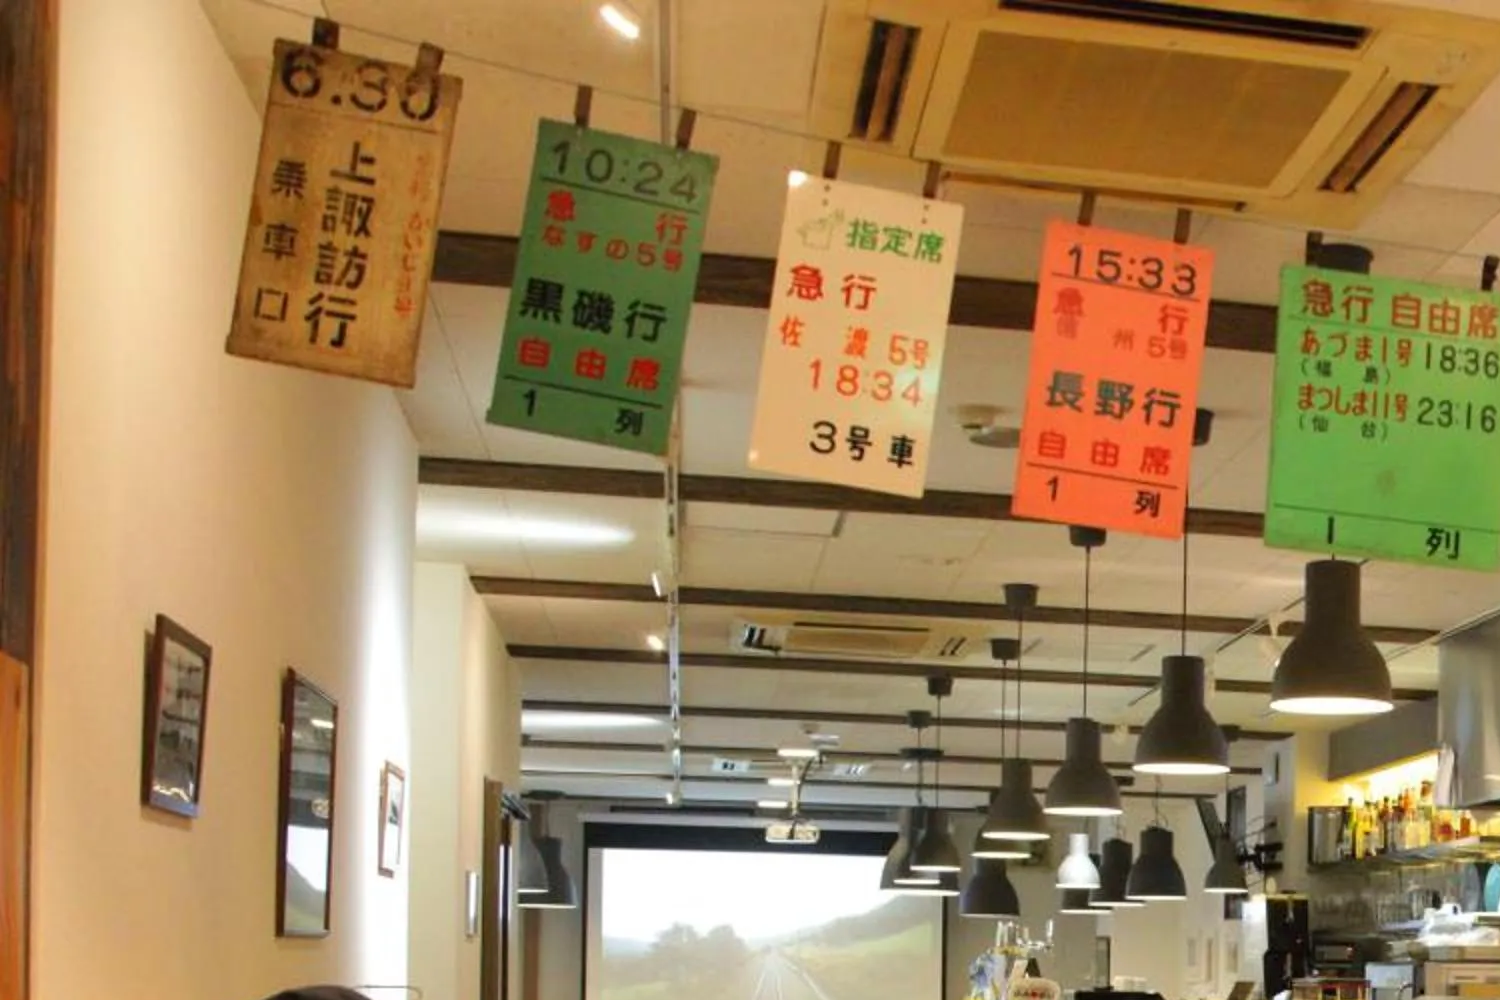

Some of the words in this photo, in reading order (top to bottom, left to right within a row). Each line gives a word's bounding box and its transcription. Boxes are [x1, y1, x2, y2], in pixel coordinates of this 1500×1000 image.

[551, 141, 699, 202] 10:24
[253, 159, 307, 324] 乗車口
[543, 191, 688, 246] 急行
[845, 218, 945, 263] 指定席
[305, 142, 377, 349] 上諏訪行
[541, 225, 685, 273] なすの5号
[1068, 245, 1196, 296] 15:33
[519, 278, 668, 343] 黒磯行
[786, 264, 876, 311] 急行
[1052, 288, 1189, 335] 急行
[1302, 279, 1374, 324] 急行
[1391, 293, 1500, 340] 自由席
[517, 338, 662, 390] 自由席
[780, 315, 930, 368] 佐渡5号
[1425, 342, 1500, 379] 18:36
[1046, 371, 1182, 429] 長野行
[1417, 397, 1497, 433] 23:16
[809, 420, 916, 468] 3号車
[1038, 430, 1172, 475] 自由席
